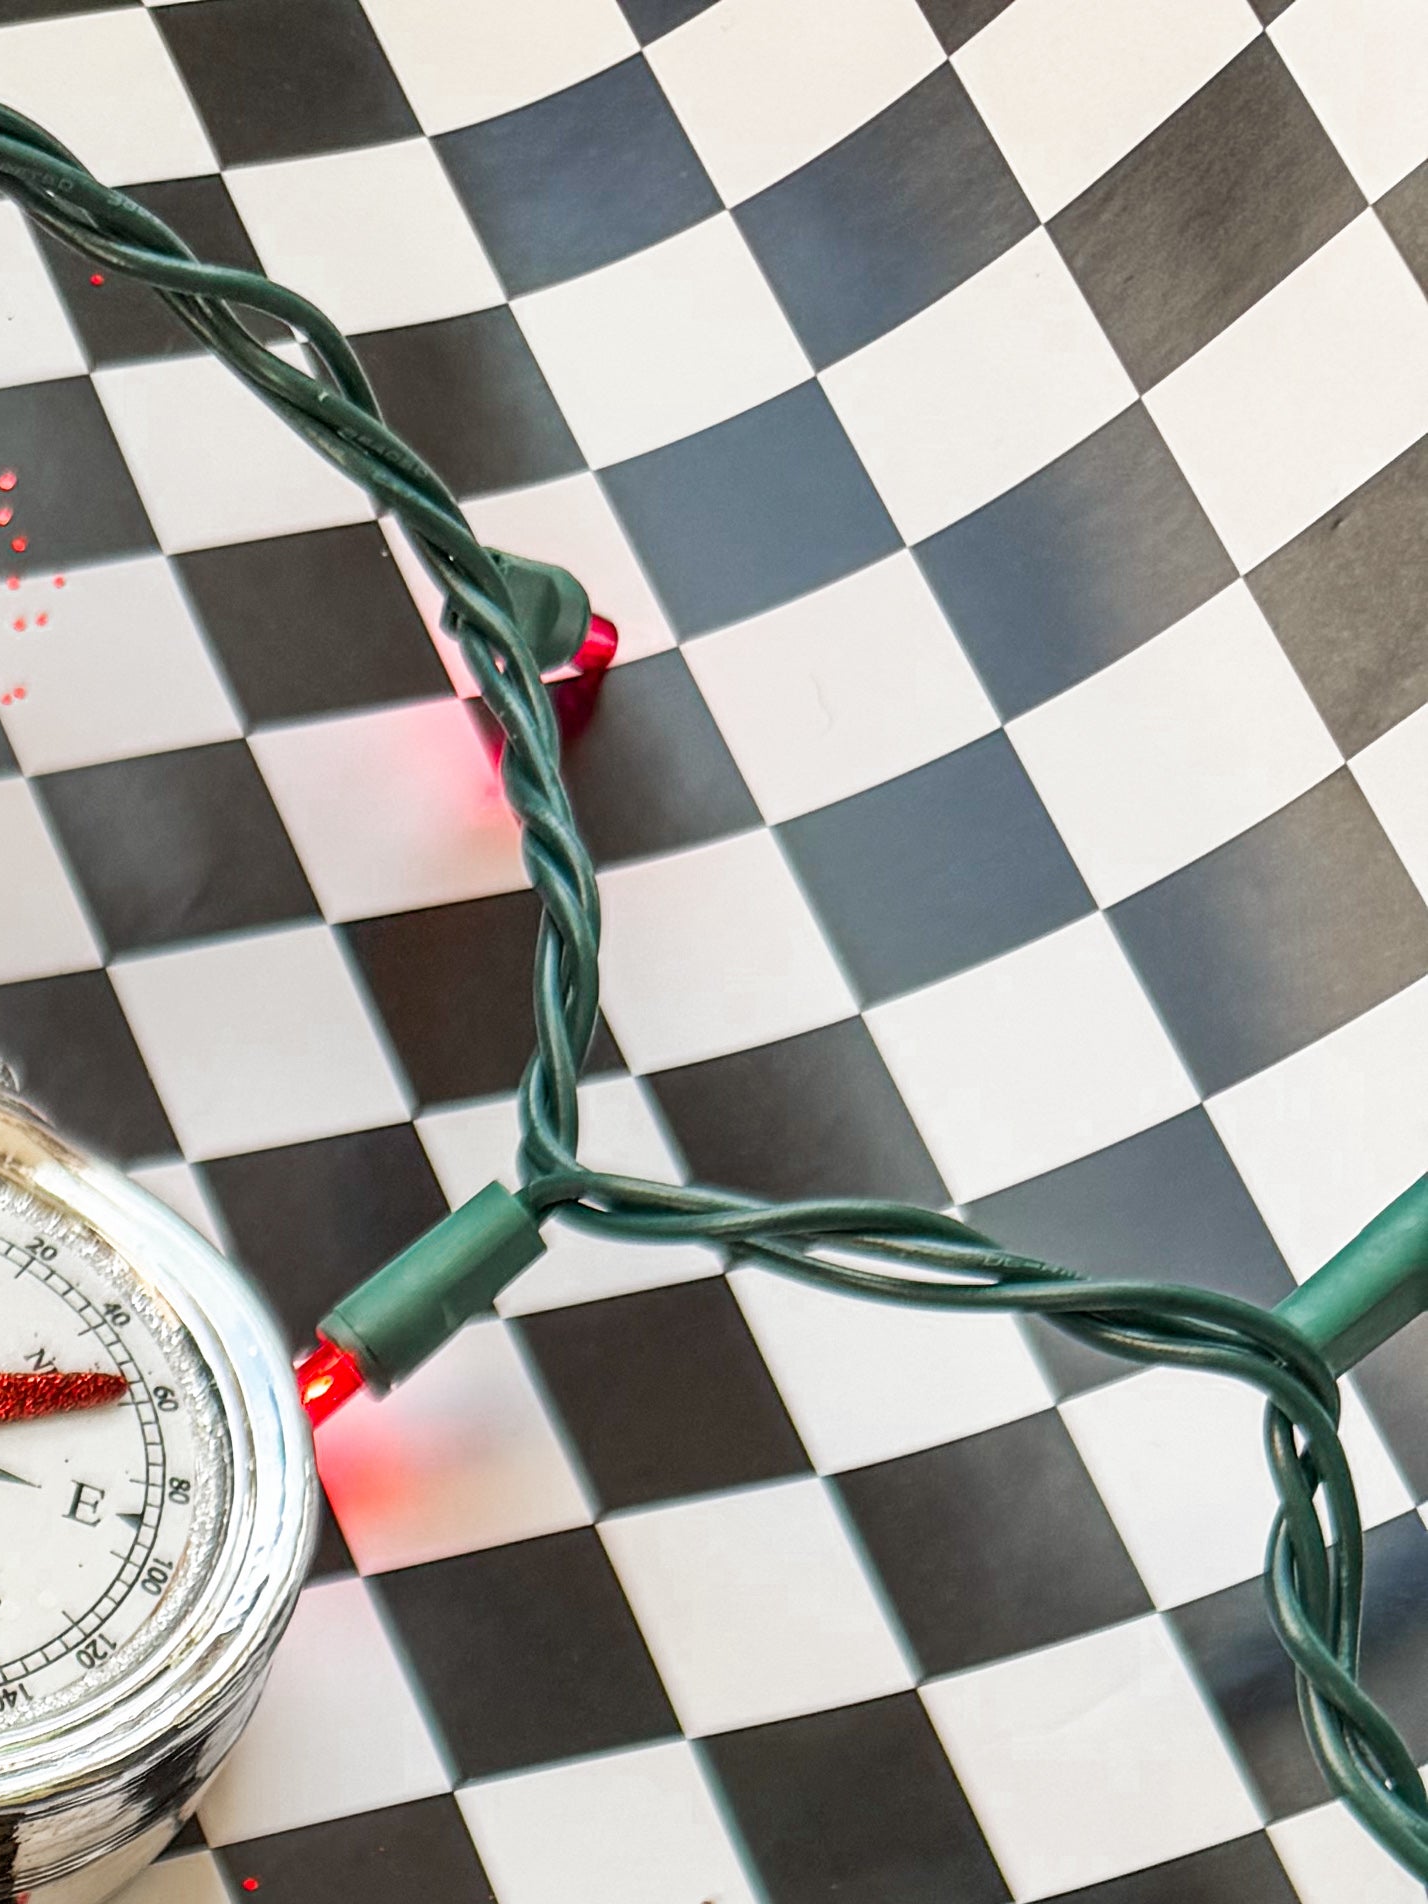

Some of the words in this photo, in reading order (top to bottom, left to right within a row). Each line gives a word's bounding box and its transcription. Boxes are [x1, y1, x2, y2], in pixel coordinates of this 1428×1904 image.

[26, 1237, 58, 1262] 20
[103, 1301, 131, 1327] 40
[153, 1385, 179, 1412] 60
[62, 1480, 105, 1528] E
[168, 1476, 191, 1505] 80
[140, 1557, 174, 1596] 100
[76, 1633, 117, 1669] 120
